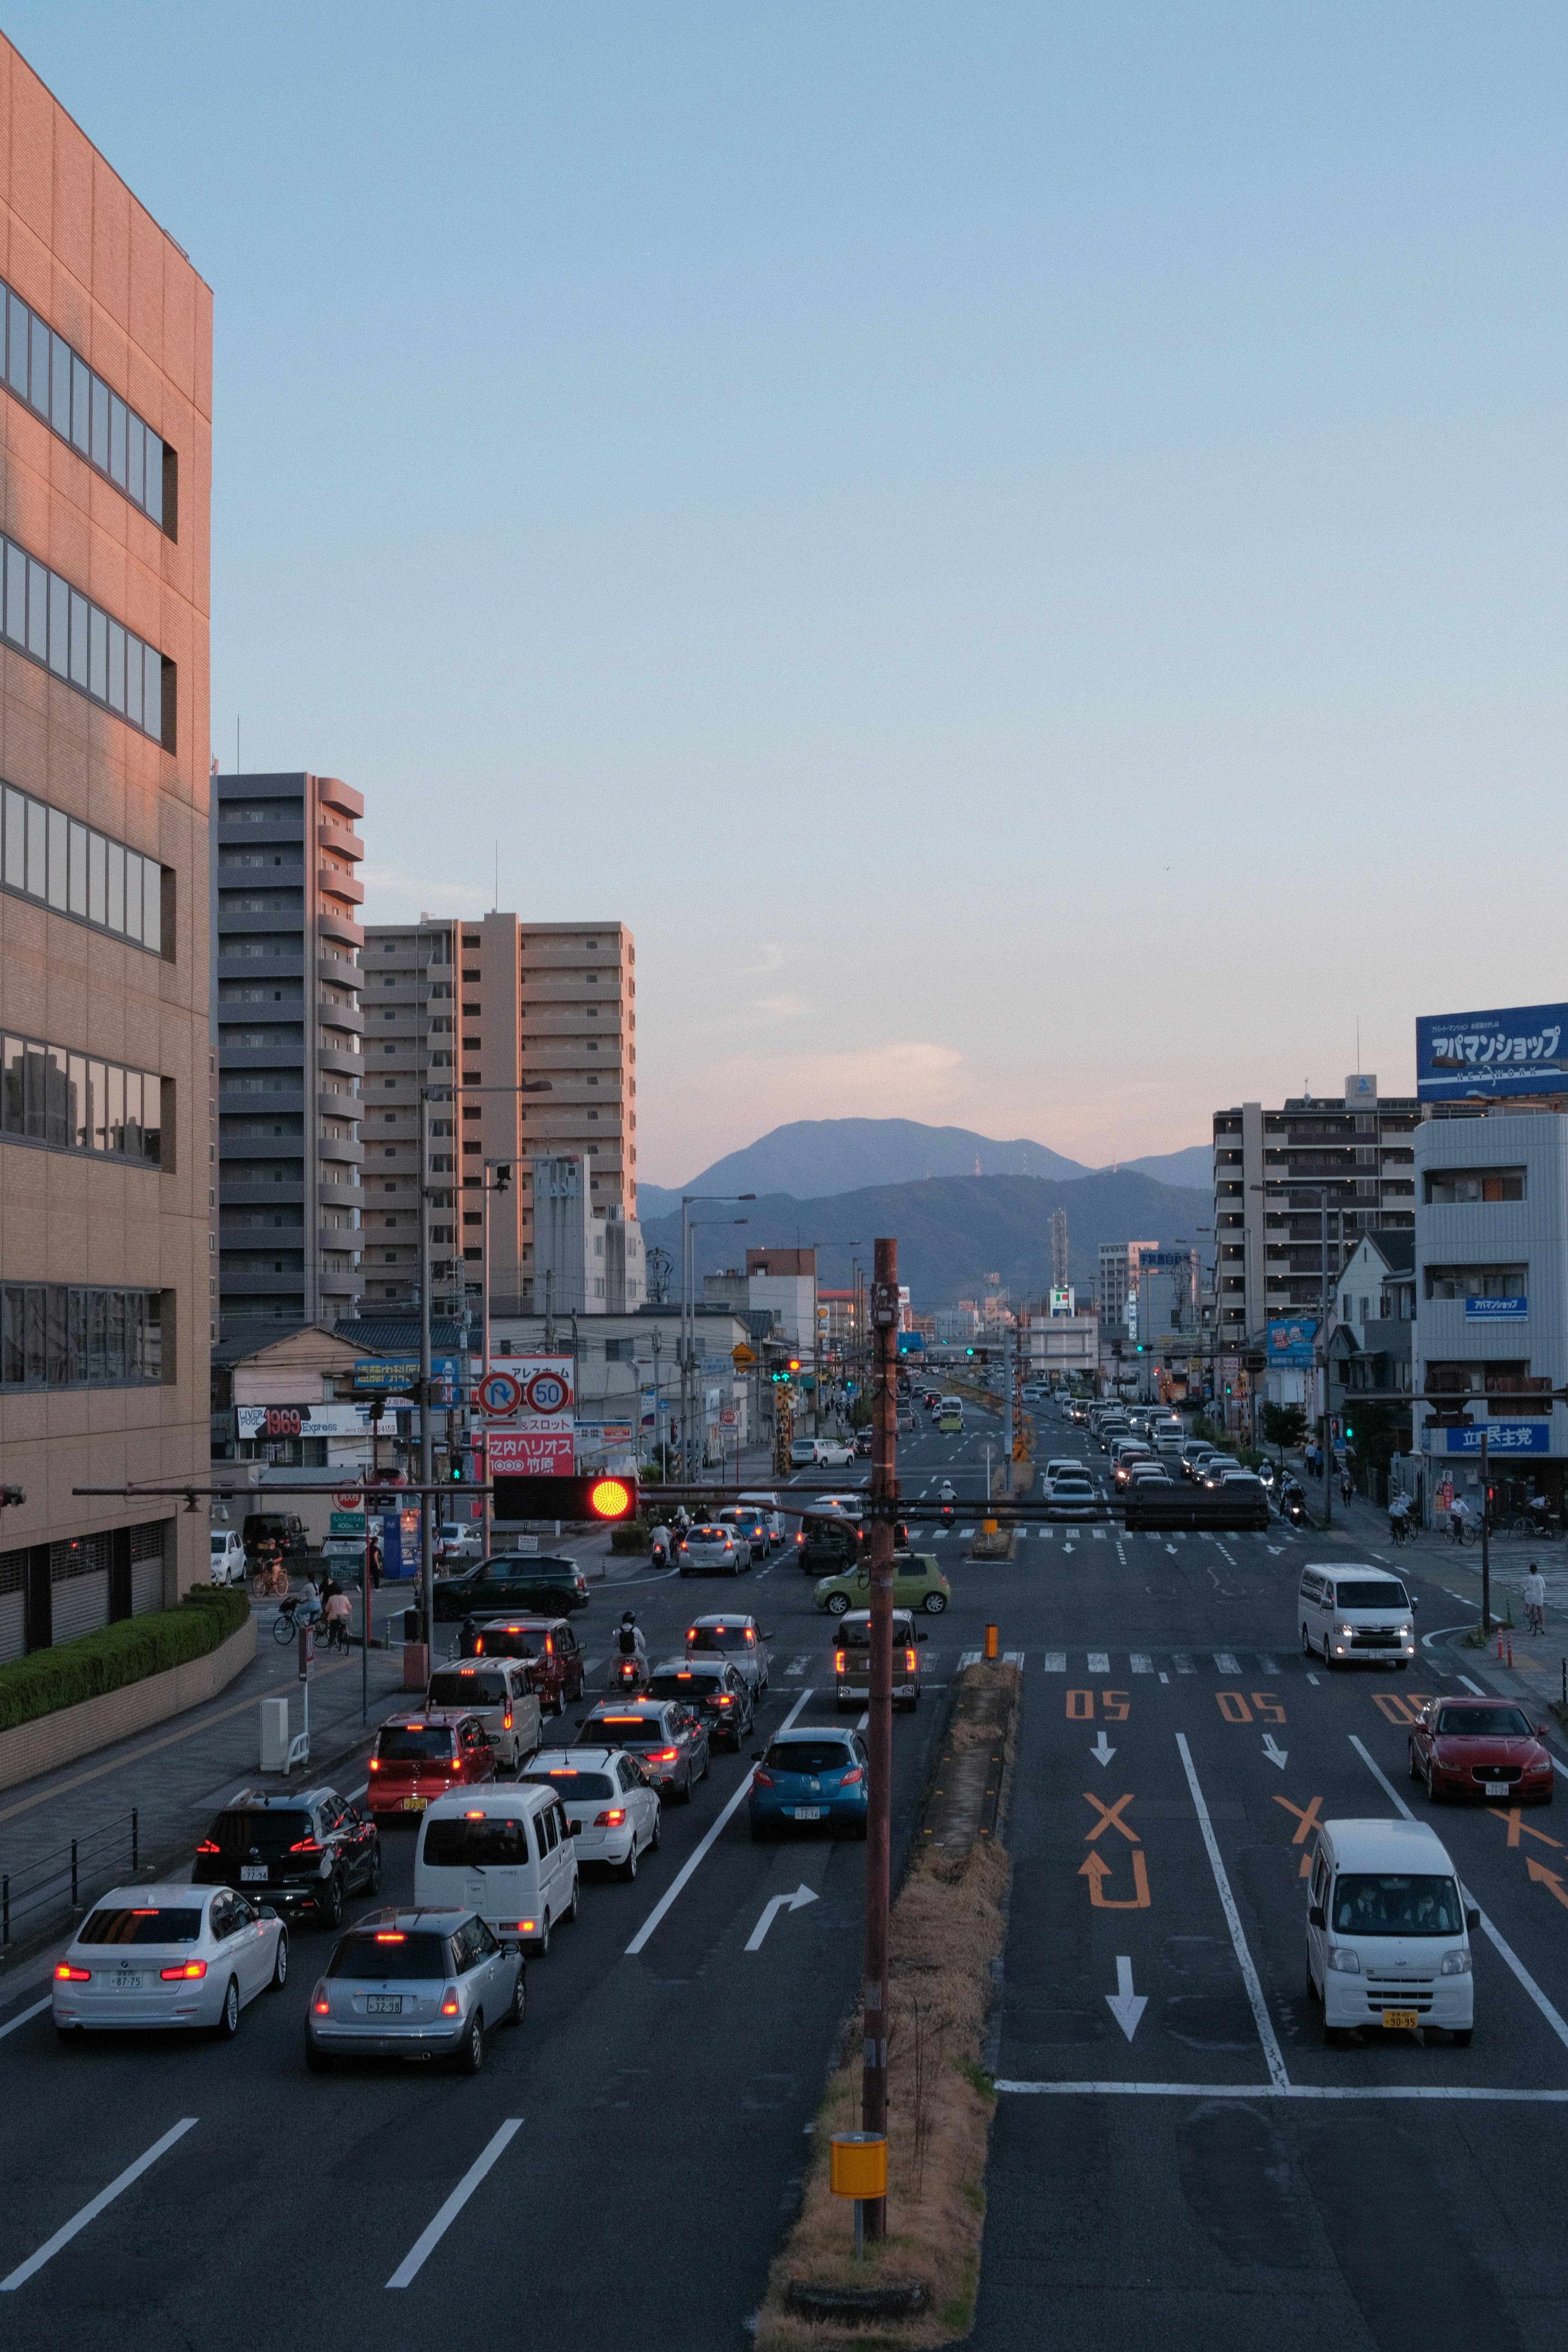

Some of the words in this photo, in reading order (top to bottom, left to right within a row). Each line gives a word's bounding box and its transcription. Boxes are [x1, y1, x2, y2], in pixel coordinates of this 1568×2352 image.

[1432, 1026, 1561, 1062] アパマンショップ
[1474, 1299, 1518, 1309] アパマンショップ
[536, 1384, 559, 1403] 50
[239, 1410, 263, 1418] LIVER
[265, 1409, 301, 1435] 1969
[302, 1423, 337, 1433] Express
[527, 1457, 554, 1473] 竹原
[117, 1977, 140, 1986] 87-75
[375, 2002, 400, 2011] 32-98
[1390, 2018, 1415, 2026] 90-95
